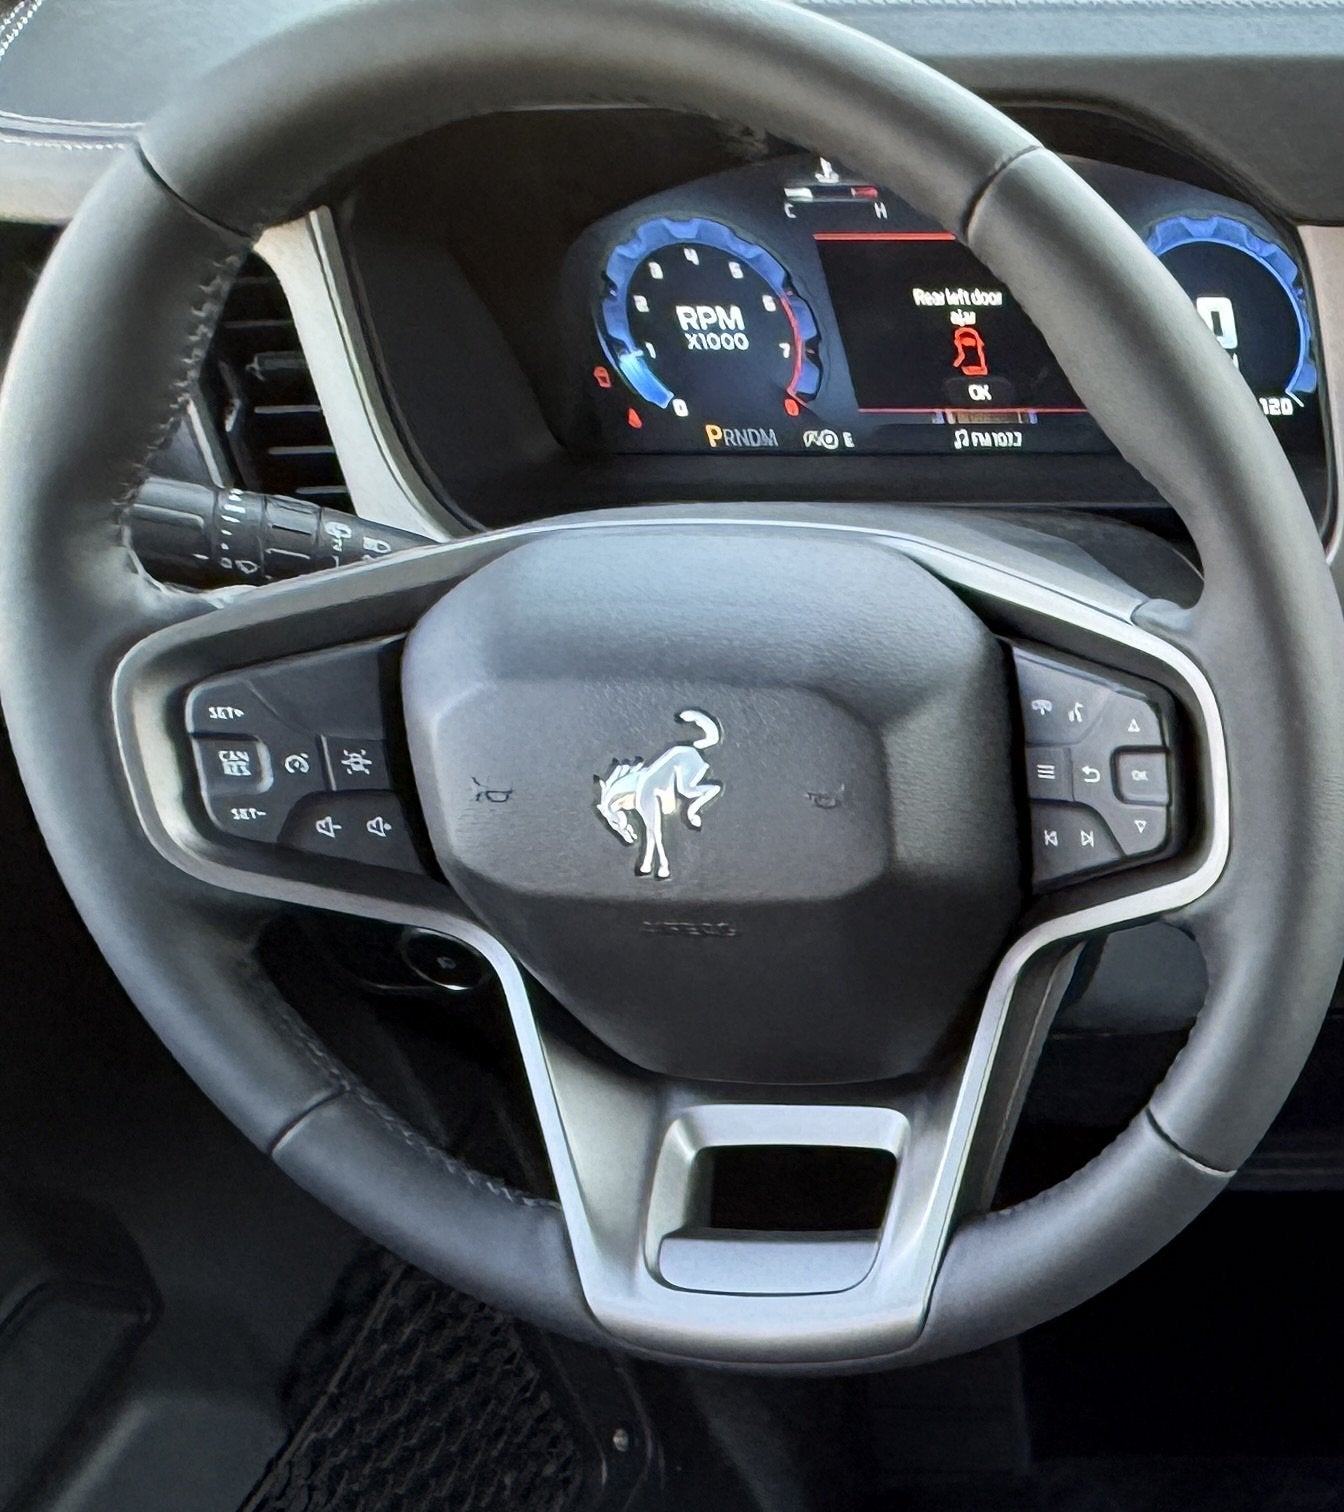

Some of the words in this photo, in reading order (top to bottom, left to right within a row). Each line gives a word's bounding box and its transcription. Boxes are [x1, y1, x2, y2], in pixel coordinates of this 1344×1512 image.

[784, 202, 797, 219] C
[873, 201, 889, 219] H
[683, 247, 700, 266] 4
[675, 304, 745, 331] RPM
[645, 341, 657, 359] 1
[779, 342, 791, 359] 7
[672, 398, 689, 417] 0
[1258, 397, 1294, 416] 120
